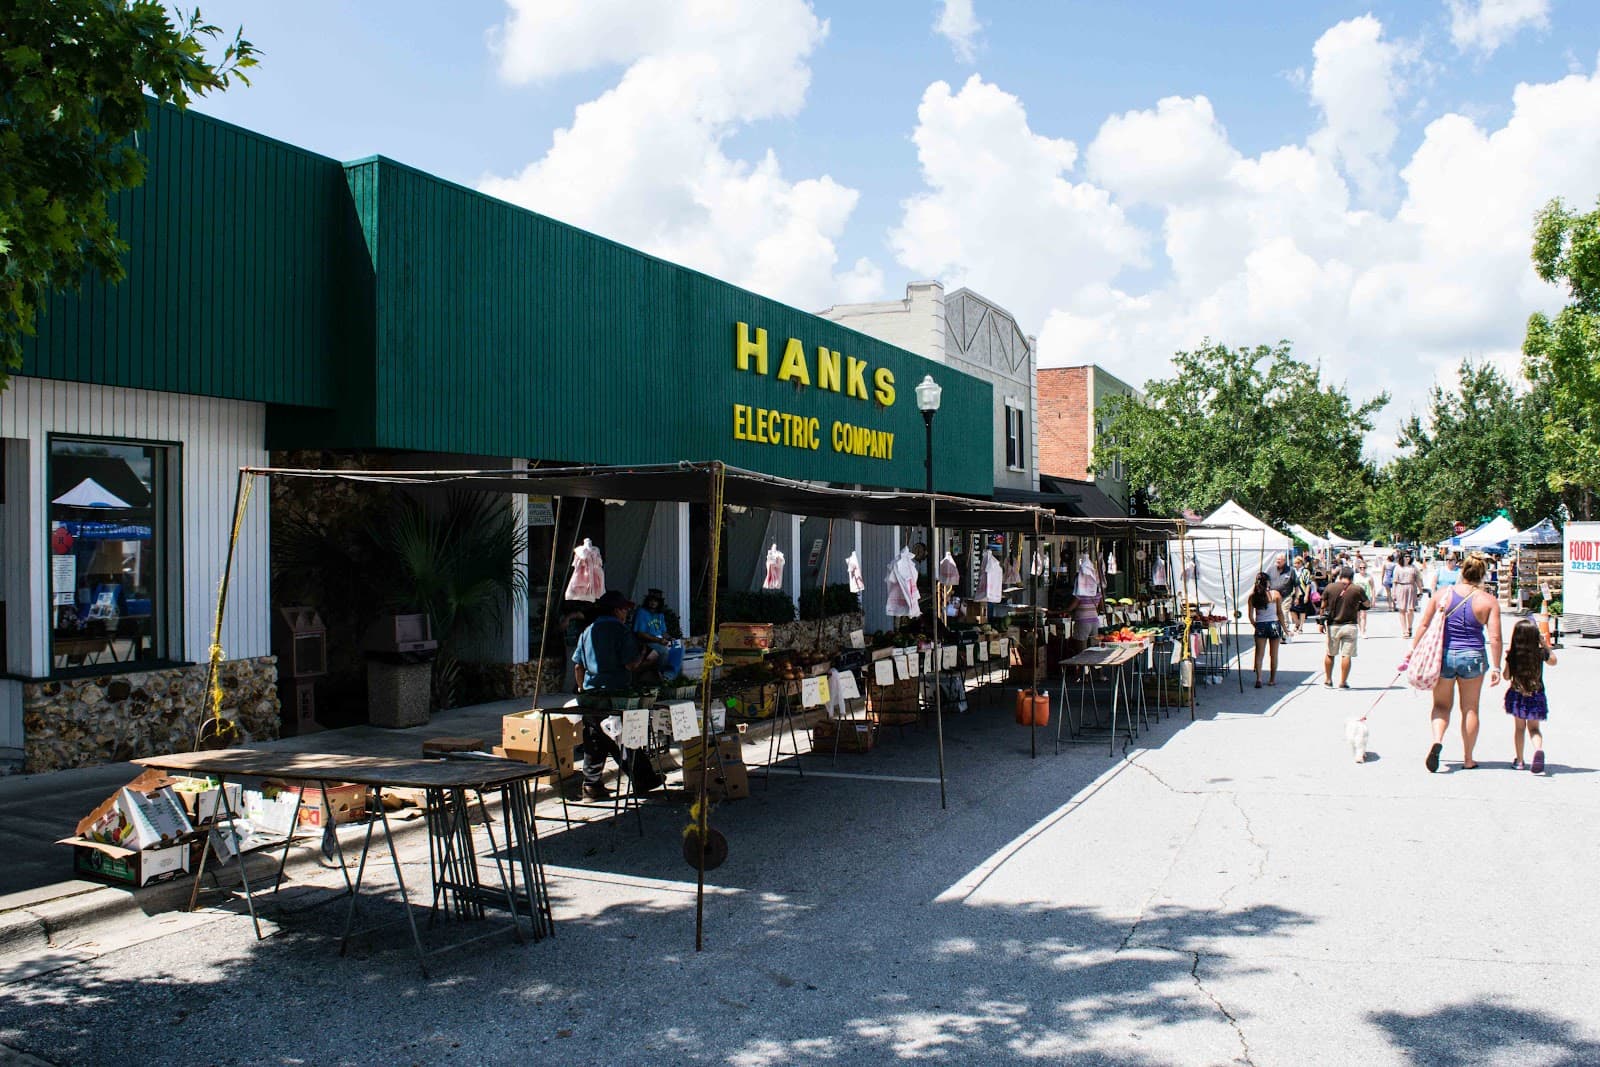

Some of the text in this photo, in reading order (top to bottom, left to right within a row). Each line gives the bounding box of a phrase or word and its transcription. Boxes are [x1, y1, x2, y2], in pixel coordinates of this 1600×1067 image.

[736, 322, 896, 406] HANKS
[733, 403, 895, 460] ELECTRIC COMPANY
[1569, 541, 1593, 561] FOOD
